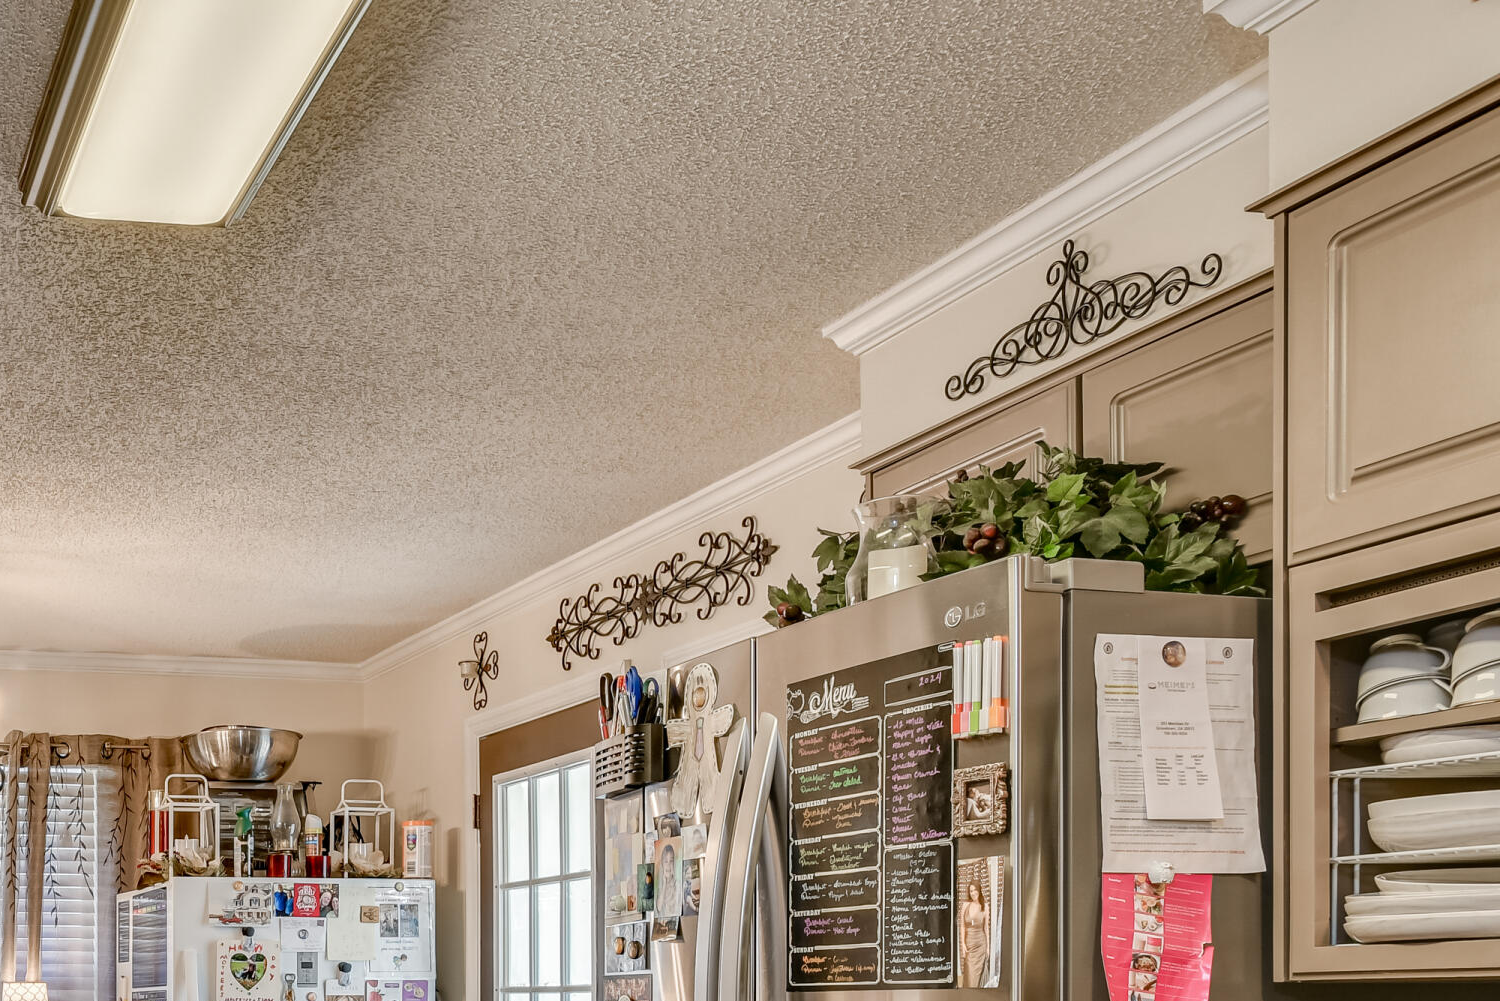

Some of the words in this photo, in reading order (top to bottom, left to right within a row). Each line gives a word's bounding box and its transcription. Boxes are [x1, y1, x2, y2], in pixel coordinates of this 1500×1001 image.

[918, 671, 942, 687] 2024
[808, 674, 858, 719] Menu
[902, 702, 933, 715] GROCERIES
[795, 728, 818, 739] MONDAY
[794, 764, 818, 775] TUESDAY
[795, 798, 828, 809] WEDNESDAY
[795, 836, 821, 845] THURSDAY
[794, 873, 814, 881] FRIDAY
[794, 909, 821, 917] SATURDAY
